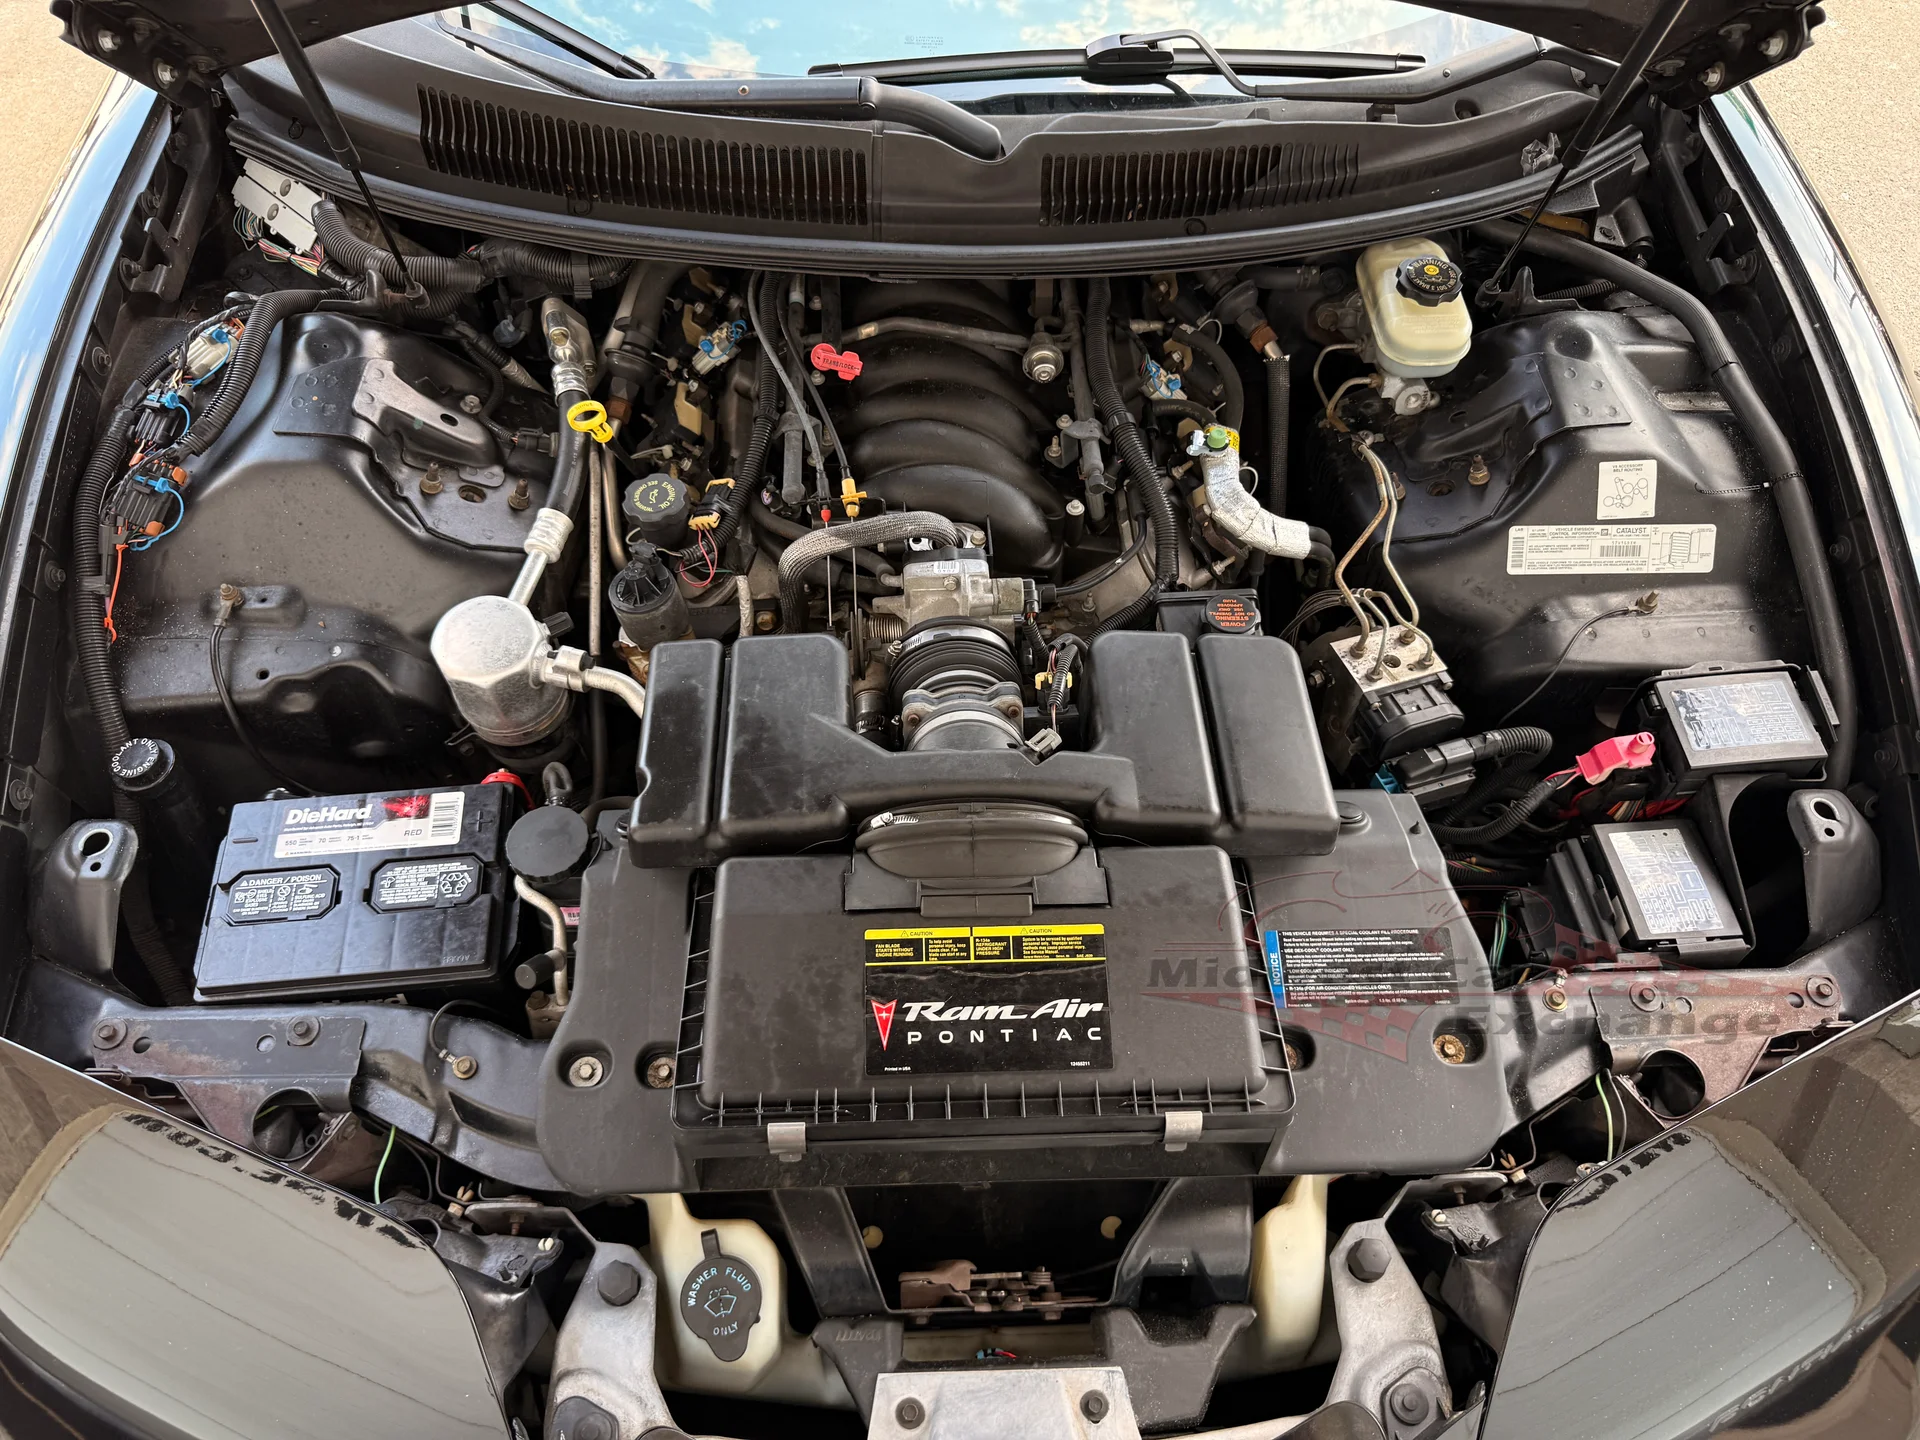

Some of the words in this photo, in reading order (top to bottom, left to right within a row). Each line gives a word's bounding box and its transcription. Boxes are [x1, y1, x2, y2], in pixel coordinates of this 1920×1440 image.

[1411, 258, 1449, 270] WARNING
[111, 738, 139, 773] COOLANT
[140, 737, 159, 755] ONLY
[120, 756, 156, 777] ENGINE
[285, 803, 374, 825] DieHard
[403, 828, 423, 837] RED
[248, 877, 284, 887] DANGER
[291, 874, 323, 883] POISON
[1269, 952, 1282, 986] NOTICE
[902, 1001, 1027, 1022] Ram
[1030, 998, 1104, 1019] Air
[907, 1027, 1102, 1045] PONTIAC
[687, 1267, 718, 1307] WASHER
[725, 1266, 752, 1292] FLUID
[713, 1321, 738, 1336] ONLY
